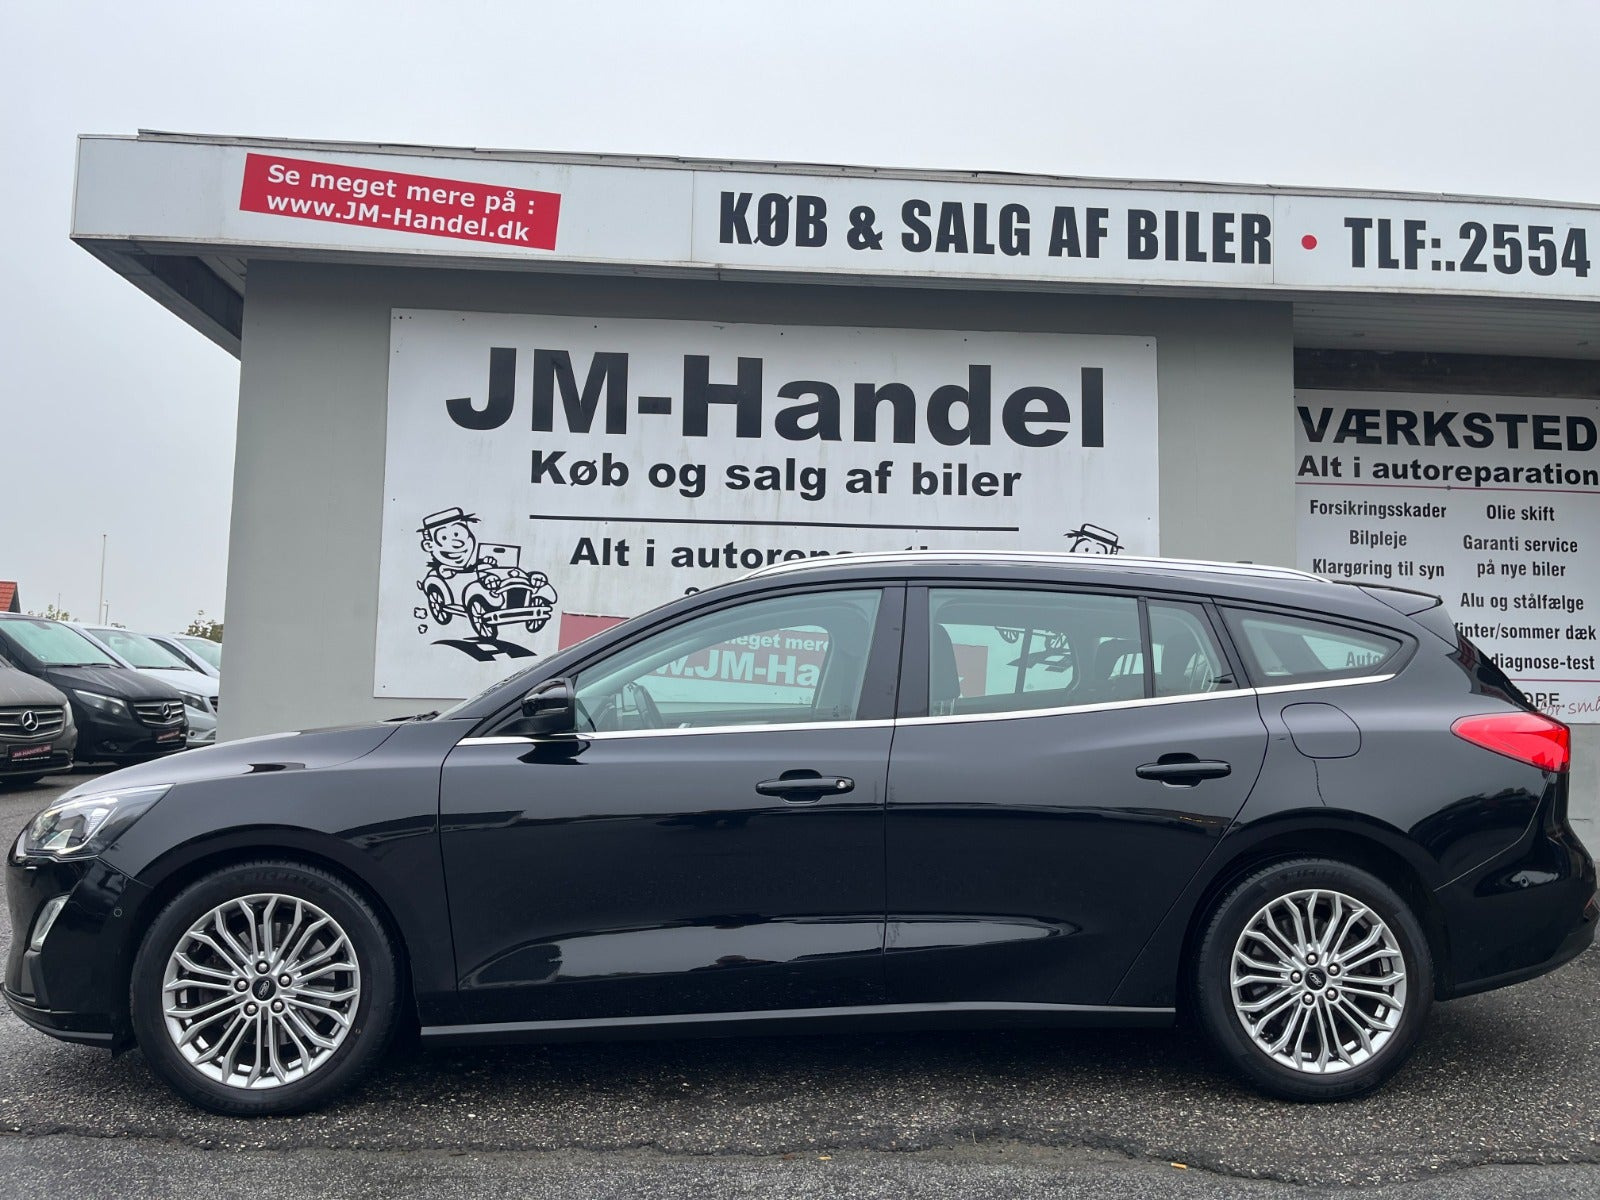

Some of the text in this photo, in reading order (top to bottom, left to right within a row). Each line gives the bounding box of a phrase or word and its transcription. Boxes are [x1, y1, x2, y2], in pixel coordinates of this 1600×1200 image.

[267, 164, 300, 185] Se
[310, 172, 397, 199] meget
[407, 184, 476, 208] mere
[485, 191, 516, 215] på
[266, 194, 530, 242] www.JM-Handel.dk
[719, 191, 828, 248] KØB
[846, 205, 884, 250] &
[901, 199, 1031, 257] SALG
[1048, 205, 1109, 259] AF
[1127, 208, 1272, 264] BILER
[445, 346, 1104, 448] JM-Handel
[1296, 406, 1598, 452] VÆRKSTED
[529, 449, 1022, 501] Køb og salg af biler
[1297, 455, 1599, 487] Alt i autoreparation
[1310, 500, 1447, 519] Forsikringsskader
[1486, 504, 1555, 521] Olie skift
[570, 537, 630, 566] Alt
[645, 539, 655, 567] i
[1350, 530, 1407, 549] Bilpleje
[1463, 534, 1578, 552] Garanti service
[1312, 558, 1445, 580] Klargøring til syn
[1477, 559, 1566, 579] på nye biler
[1460, 592, 1584, 613] Alu og stålfælge
[1565, 625, 1597, 640] dæk
